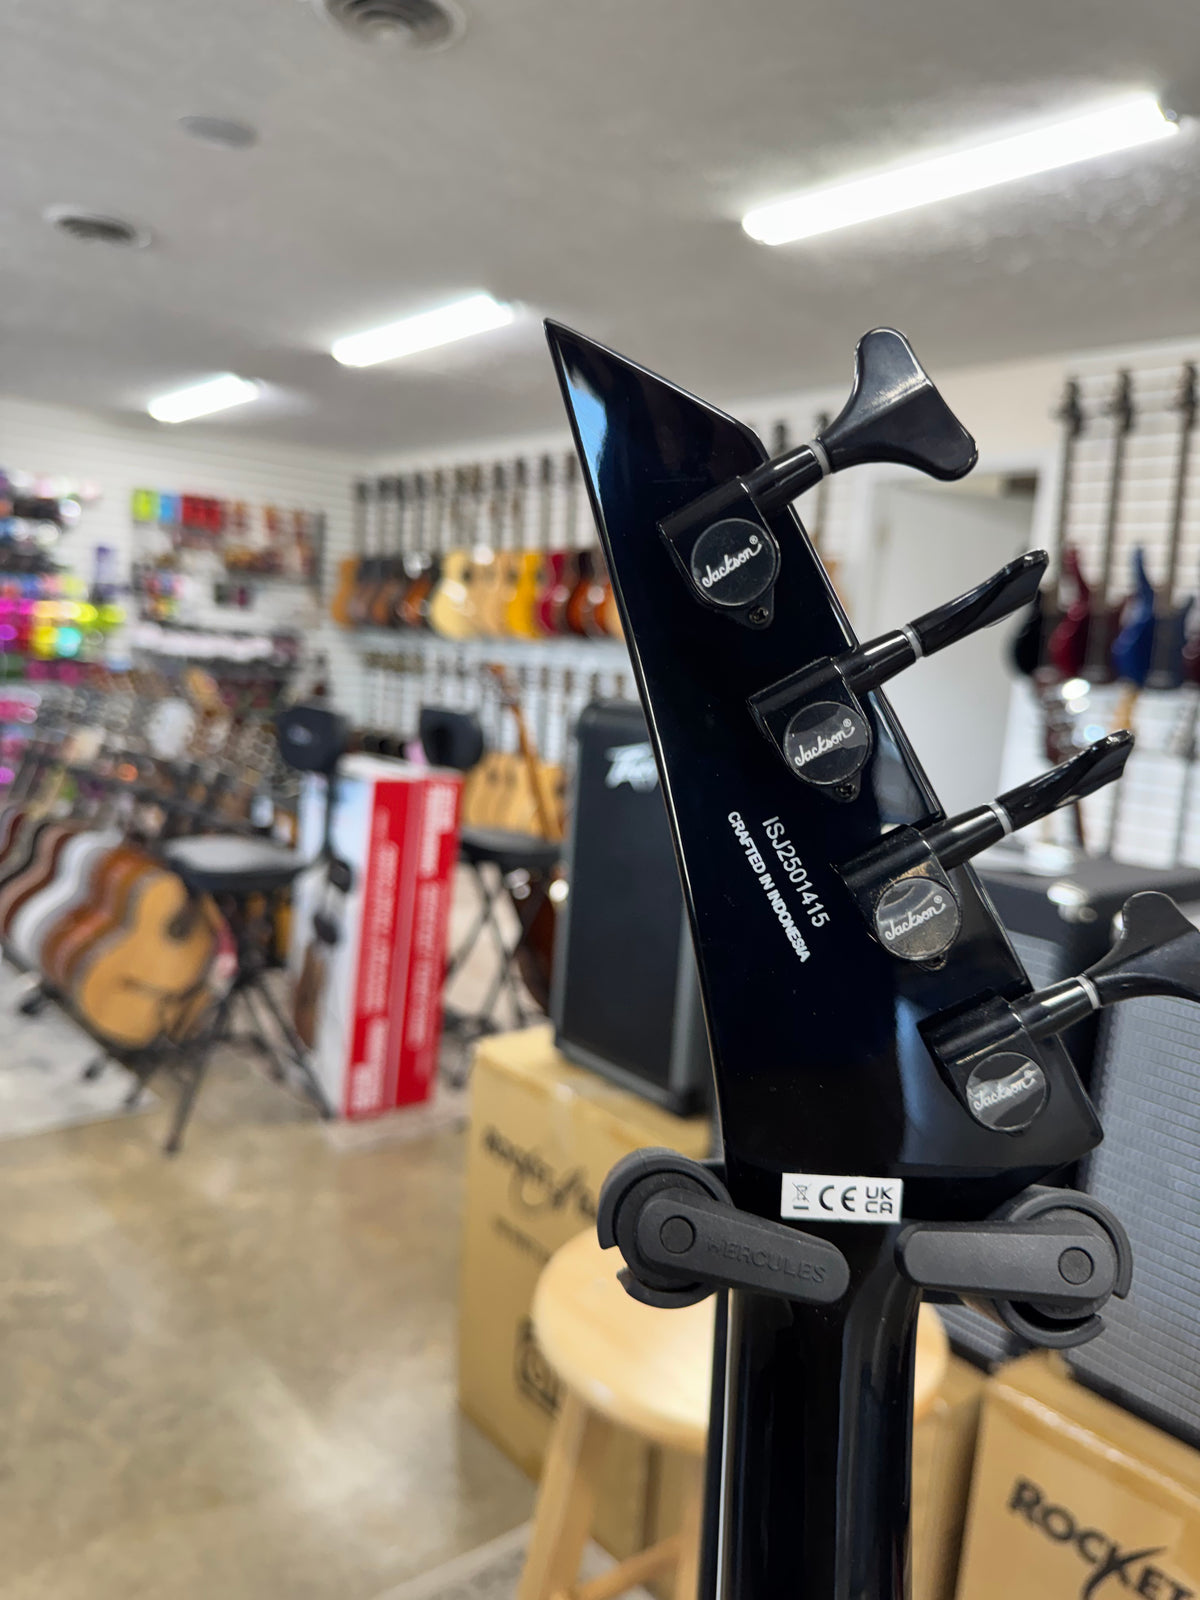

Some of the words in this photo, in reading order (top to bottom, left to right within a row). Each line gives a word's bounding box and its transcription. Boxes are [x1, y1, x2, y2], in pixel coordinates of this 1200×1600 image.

[727, 811, 766, 874] CRAFTED
[762, 816, 830, 927] ISJ2501415
[758, 873, 775, 890] IN
[766, 889, 811, 963] INDONESIA
[707, 1238, 826, 1284] HERCULES
